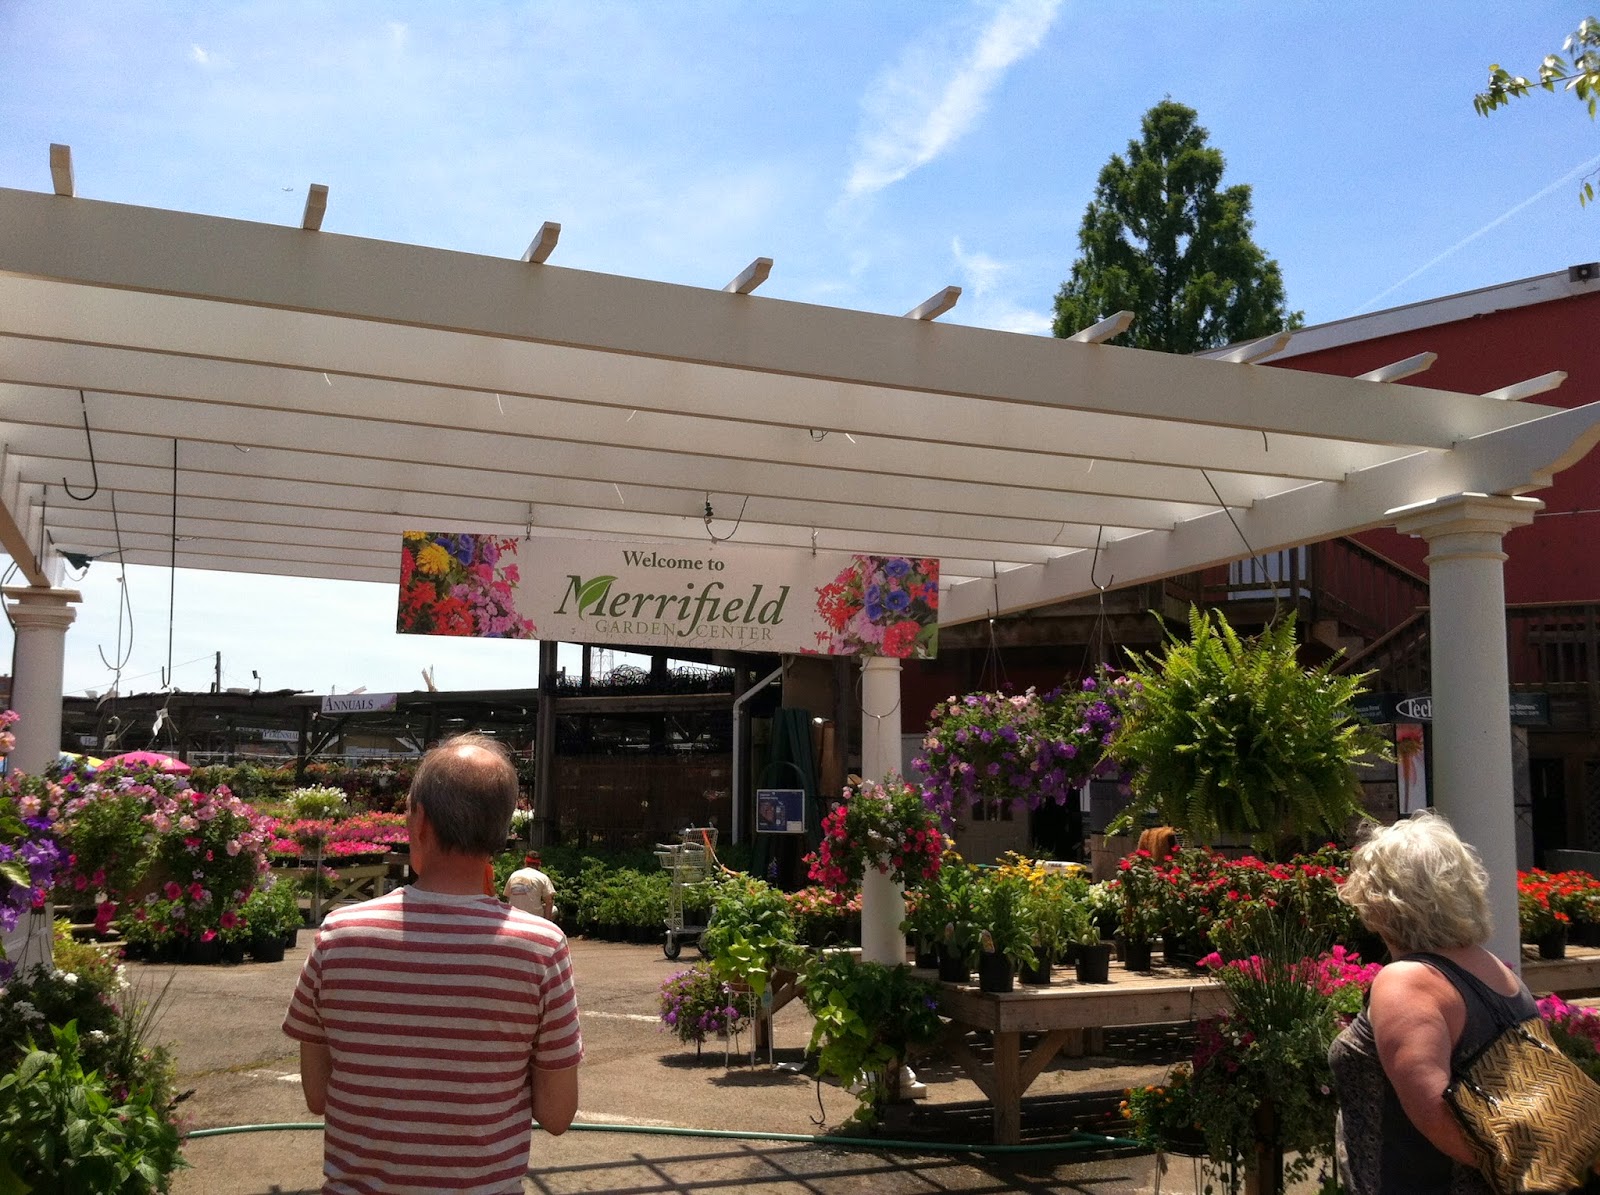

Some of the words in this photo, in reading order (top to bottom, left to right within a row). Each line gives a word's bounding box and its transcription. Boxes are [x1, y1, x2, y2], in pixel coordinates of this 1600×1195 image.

[622, 550, 704, 570] Welcome
[707, 557, 725, 572] to
[553, 575, 791, 637] Merrifield
[595, 619, 677, 636] GARDEN
[695, 623, 773, 641] CENTER
[323, 697, 374, 711] ANNUALS
